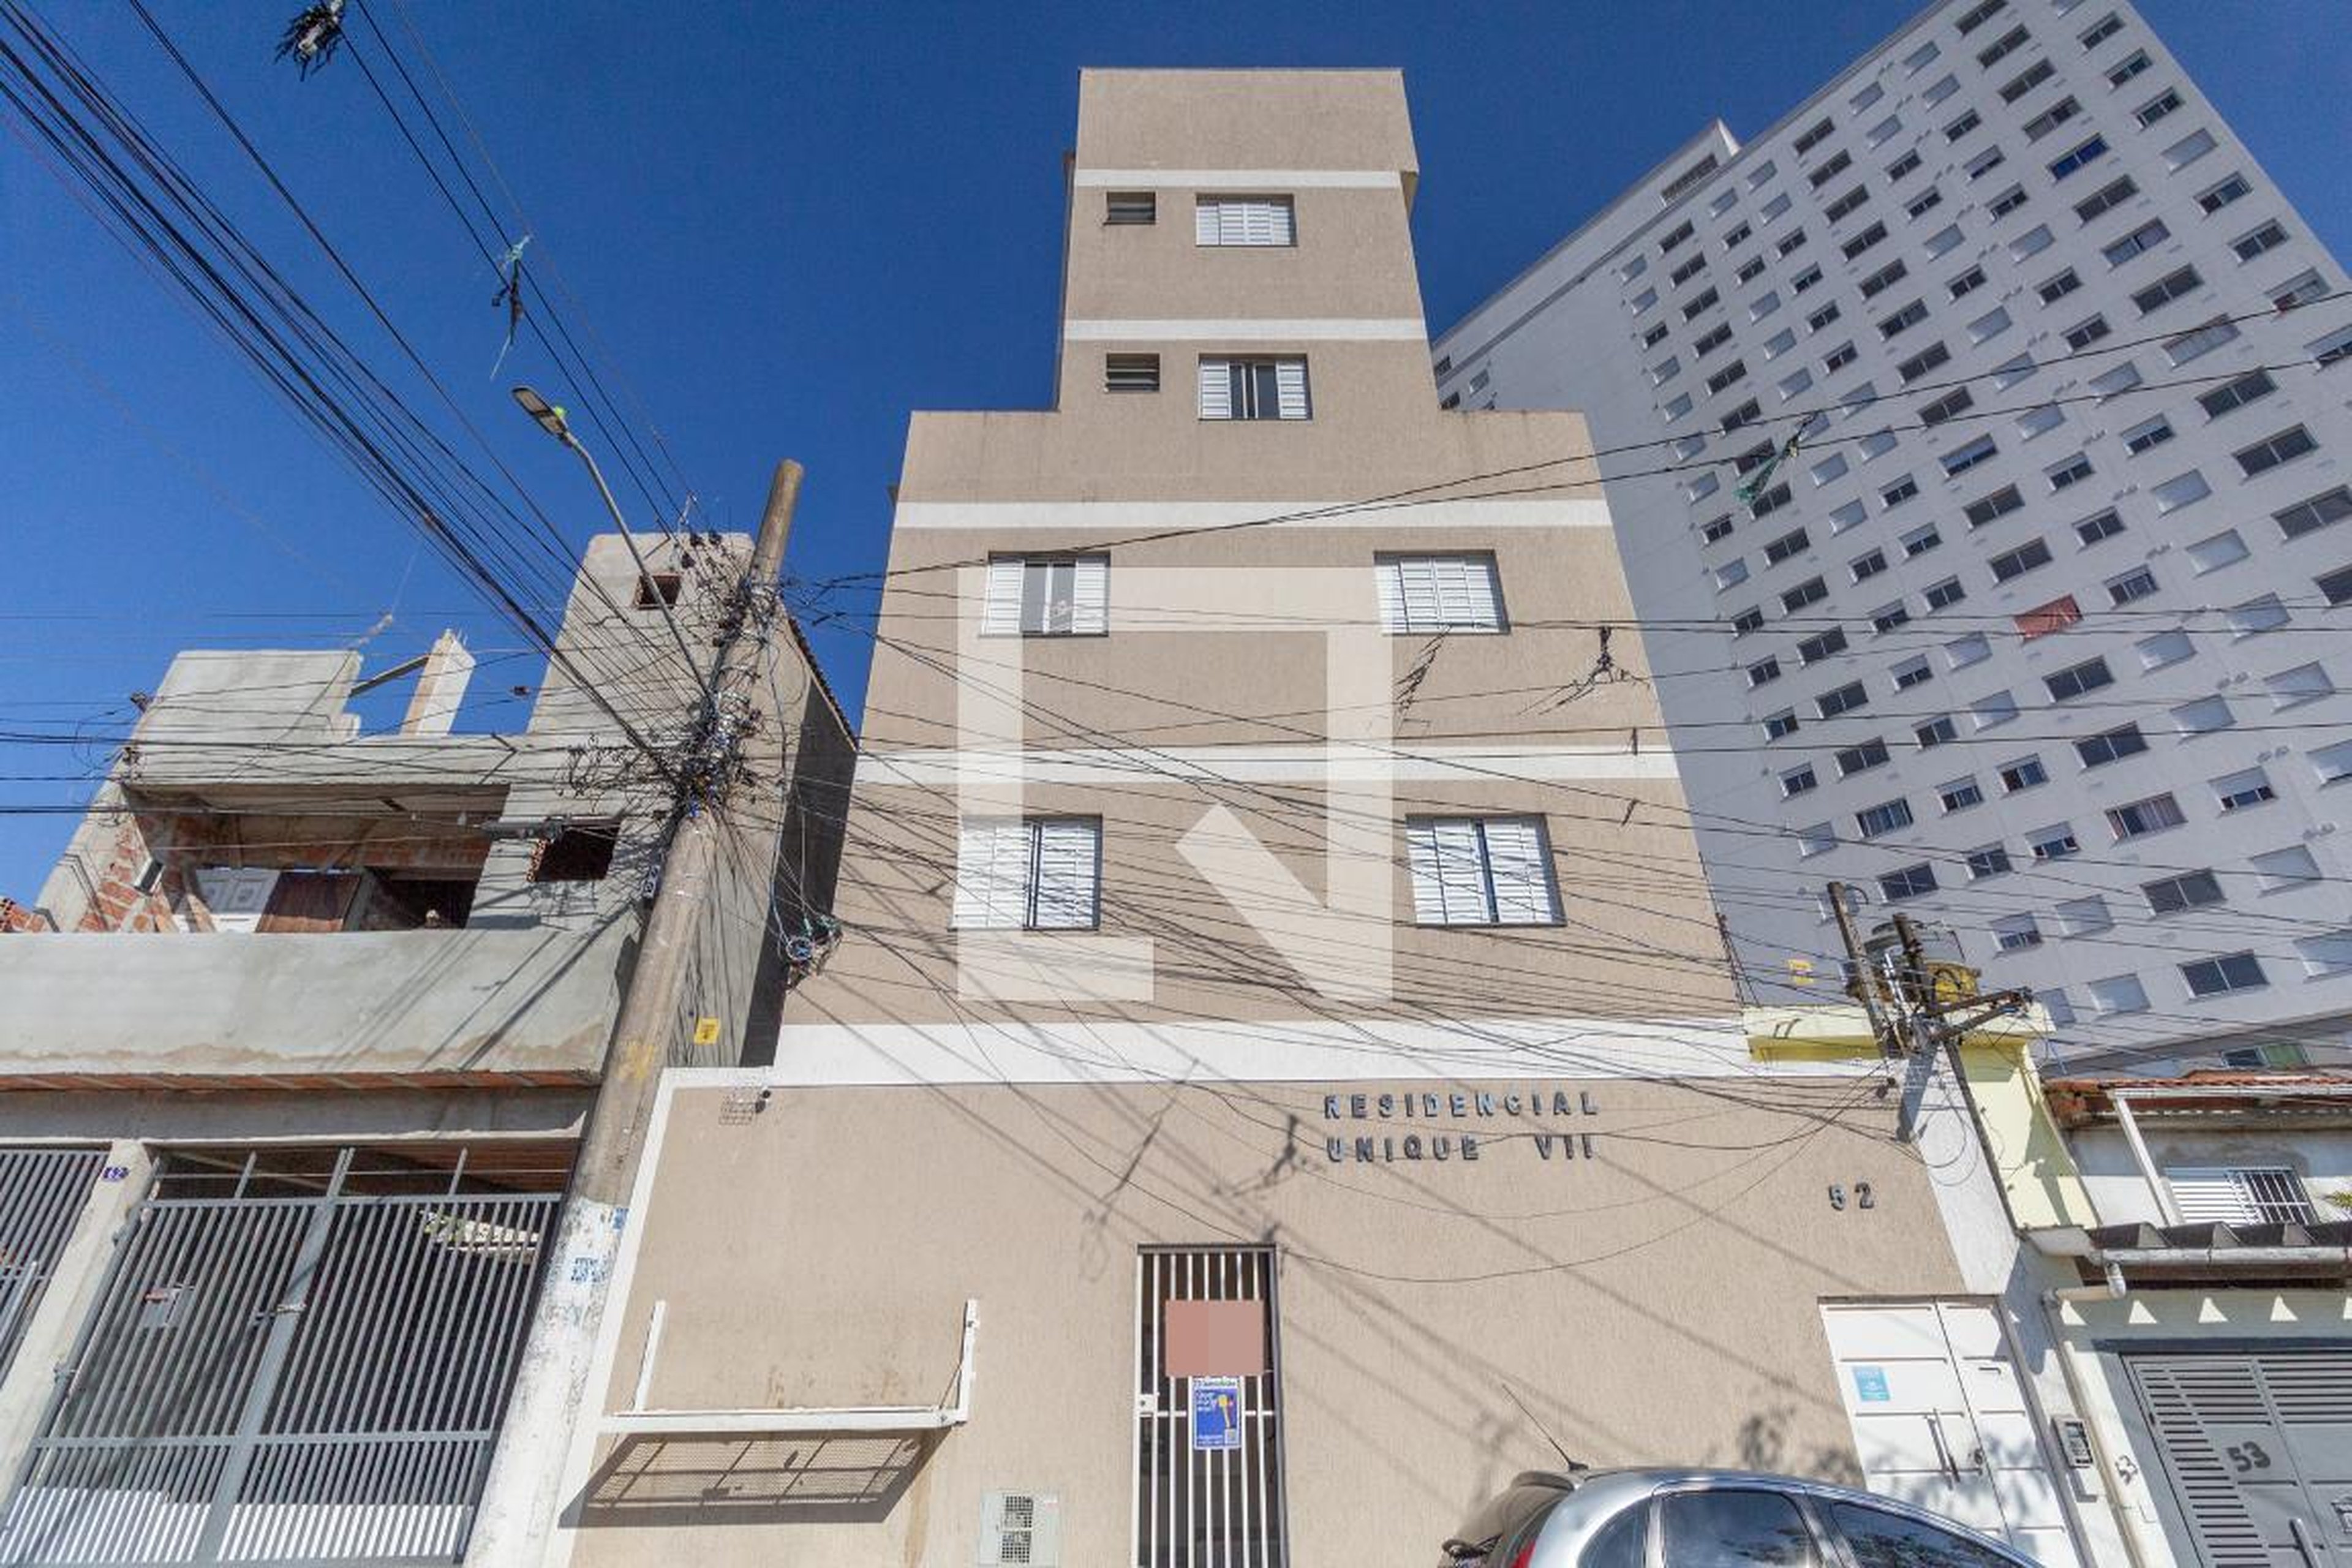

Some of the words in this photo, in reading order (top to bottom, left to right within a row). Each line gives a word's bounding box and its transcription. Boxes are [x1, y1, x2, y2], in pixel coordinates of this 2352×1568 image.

[1324, 1091, 1599, 1119] RESIDENCIAL
[1325, 1134, 1479, 1163] UNIQUE
[1534, 1134, 1594, 1160] VII
[1828, 1182, 1875, 1211] 52
[2226, 1441, 2271, 1472] 53
